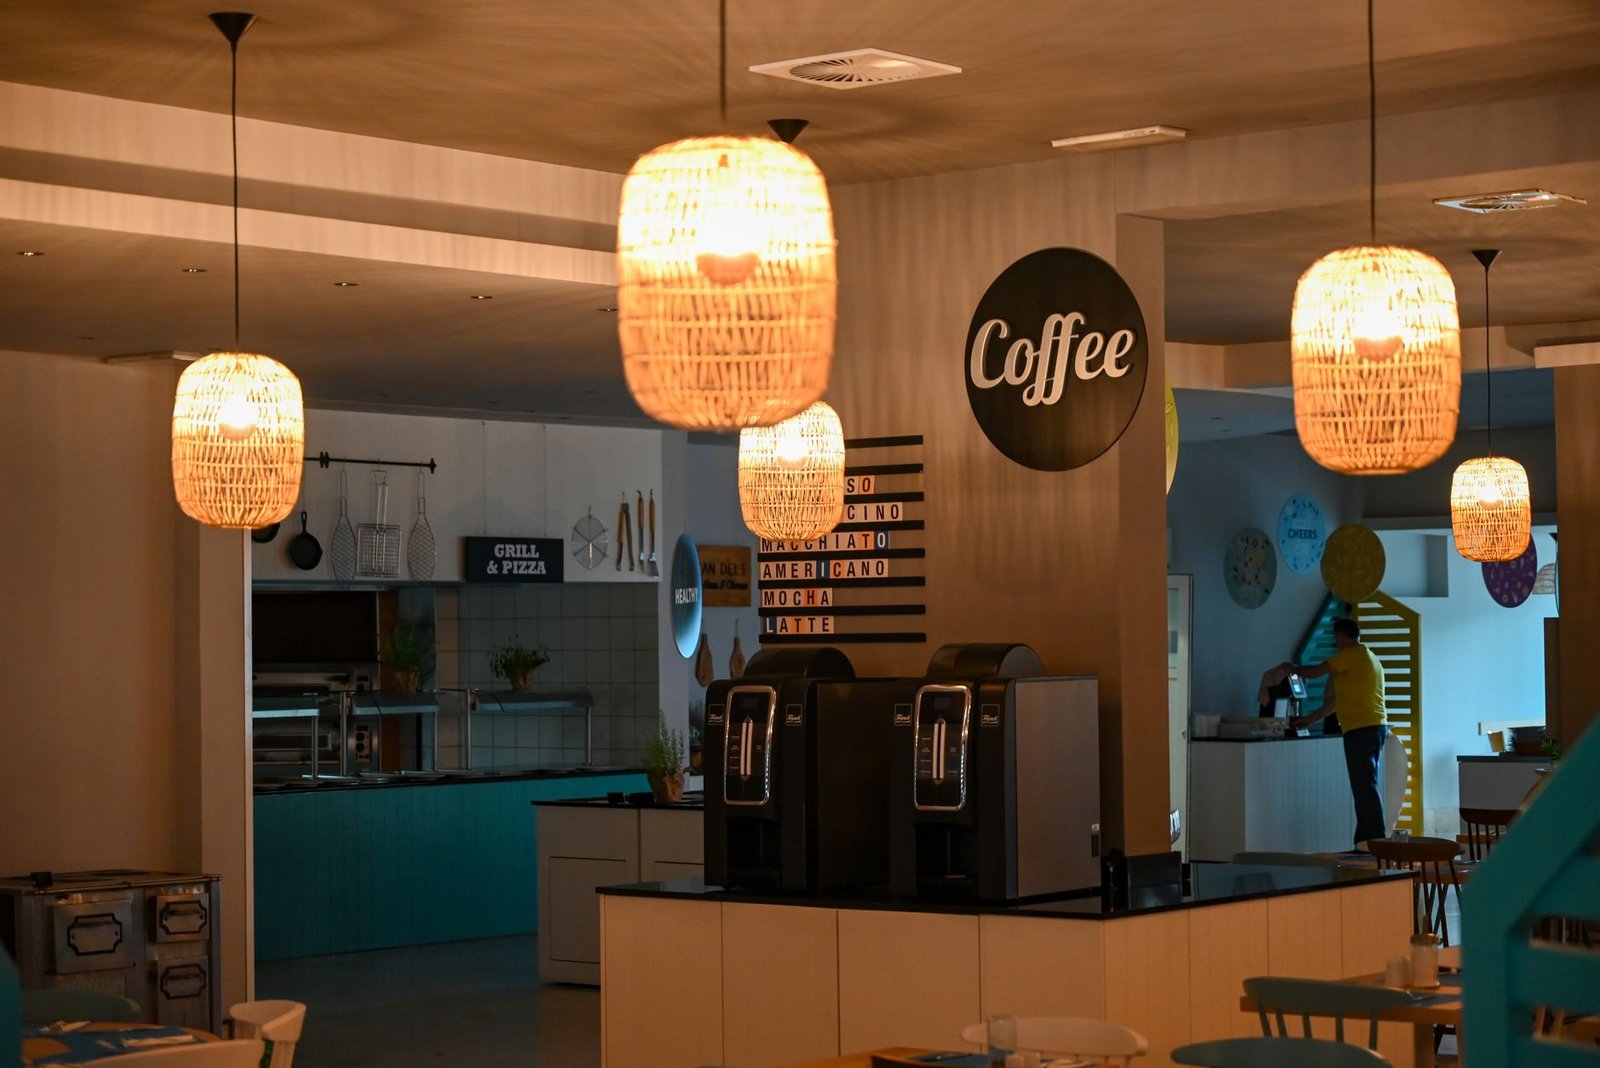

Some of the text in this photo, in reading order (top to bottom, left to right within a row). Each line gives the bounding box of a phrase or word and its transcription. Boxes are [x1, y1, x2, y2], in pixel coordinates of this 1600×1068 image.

[970, 311, 1135, 406] Coffee
[761, 532, 886, 551] MACCHIATO
[1288, 528, 1318, 540] CHEERS
[494, 544, 539, 559] GRILL
[486, 560, 547, 575] & PIZZA
[763, 560, 885, 579] AMERICANO
[674, 587, 699, 605] HEALTHY
[763, 590, 830, 606] MOCHA
[766, 617, 830, 633] LATTE
